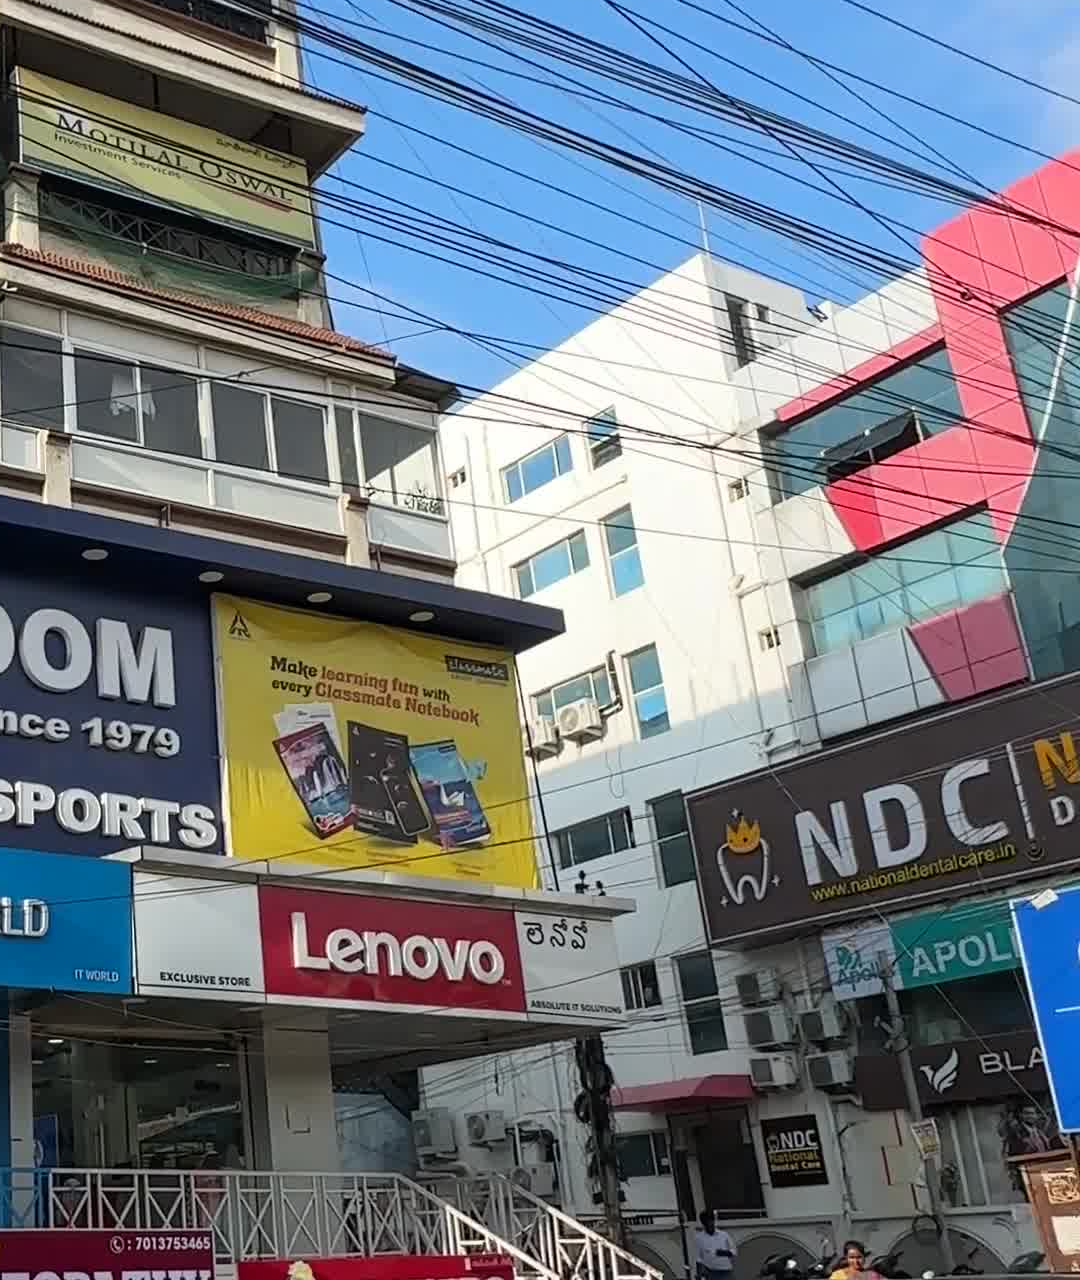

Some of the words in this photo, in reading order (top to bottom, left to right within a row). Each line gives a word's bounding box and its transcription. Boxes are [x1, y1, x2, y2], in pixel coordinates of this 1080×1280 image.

[55, 132, 127, 165] Investment
[131, 156, 182, 180] Services
[270, 655, 317, 679] Make
[321, 666, 388, 695] learning
[392, 676, 419, 697] fun
[422, 687, 450, 703] with
[271, 679, 312, 698] every
[315, 682, 401, 710] Classmate
[404, 696, 480, 727] Notebook
[81, 716, 182, 760] 1979
[795, 758, 1009, 886] NDC
[810, 842, 1016, 902] www.nationaldentalcare.in
[290, 911, 505, 985] Lenovo
[74, 969, 83, 980] IT
[85, 970, 119, 982] WORLD
[159, 972, 216, 985] EXCLUSIVE
[218, 976, 251, 987] STORE
[530, 1000, 570, 1011] ABSOLUTE
[580, 1003, 622, 1014] SOLUTIONS
[779, 1129, 817, 1149] NDC
[135, 1236, 211, 1251] 7013753465
